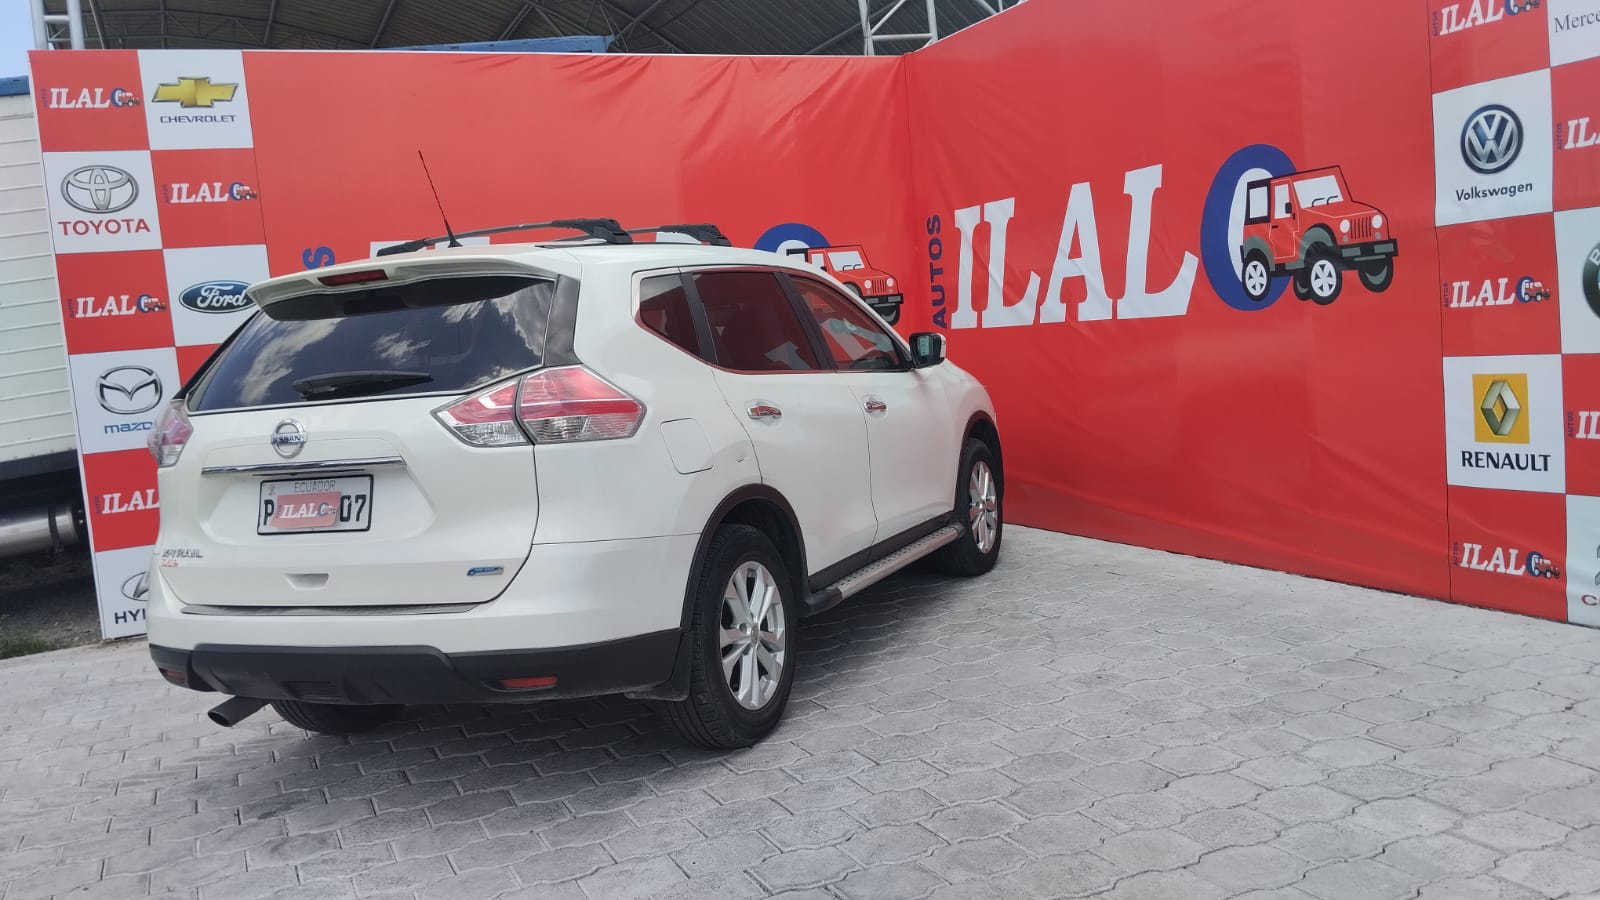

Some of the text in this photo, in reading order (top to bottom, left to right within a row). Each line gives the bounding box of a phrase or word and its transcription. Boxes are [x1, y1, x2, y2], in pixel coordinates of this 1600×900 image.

[160, 115, 236, 124] CHEVROLET
[1456, 183, 1533, 201] Volkswagen
[58, 219, 151, 236] TOYOTA
[926, 214, 947, 330] AUTOS
[197, 285, 247, 308] Ford
[1461, 451, 1552, 471] RENAULT
[294, 480, 336, 493] ECUADOR
